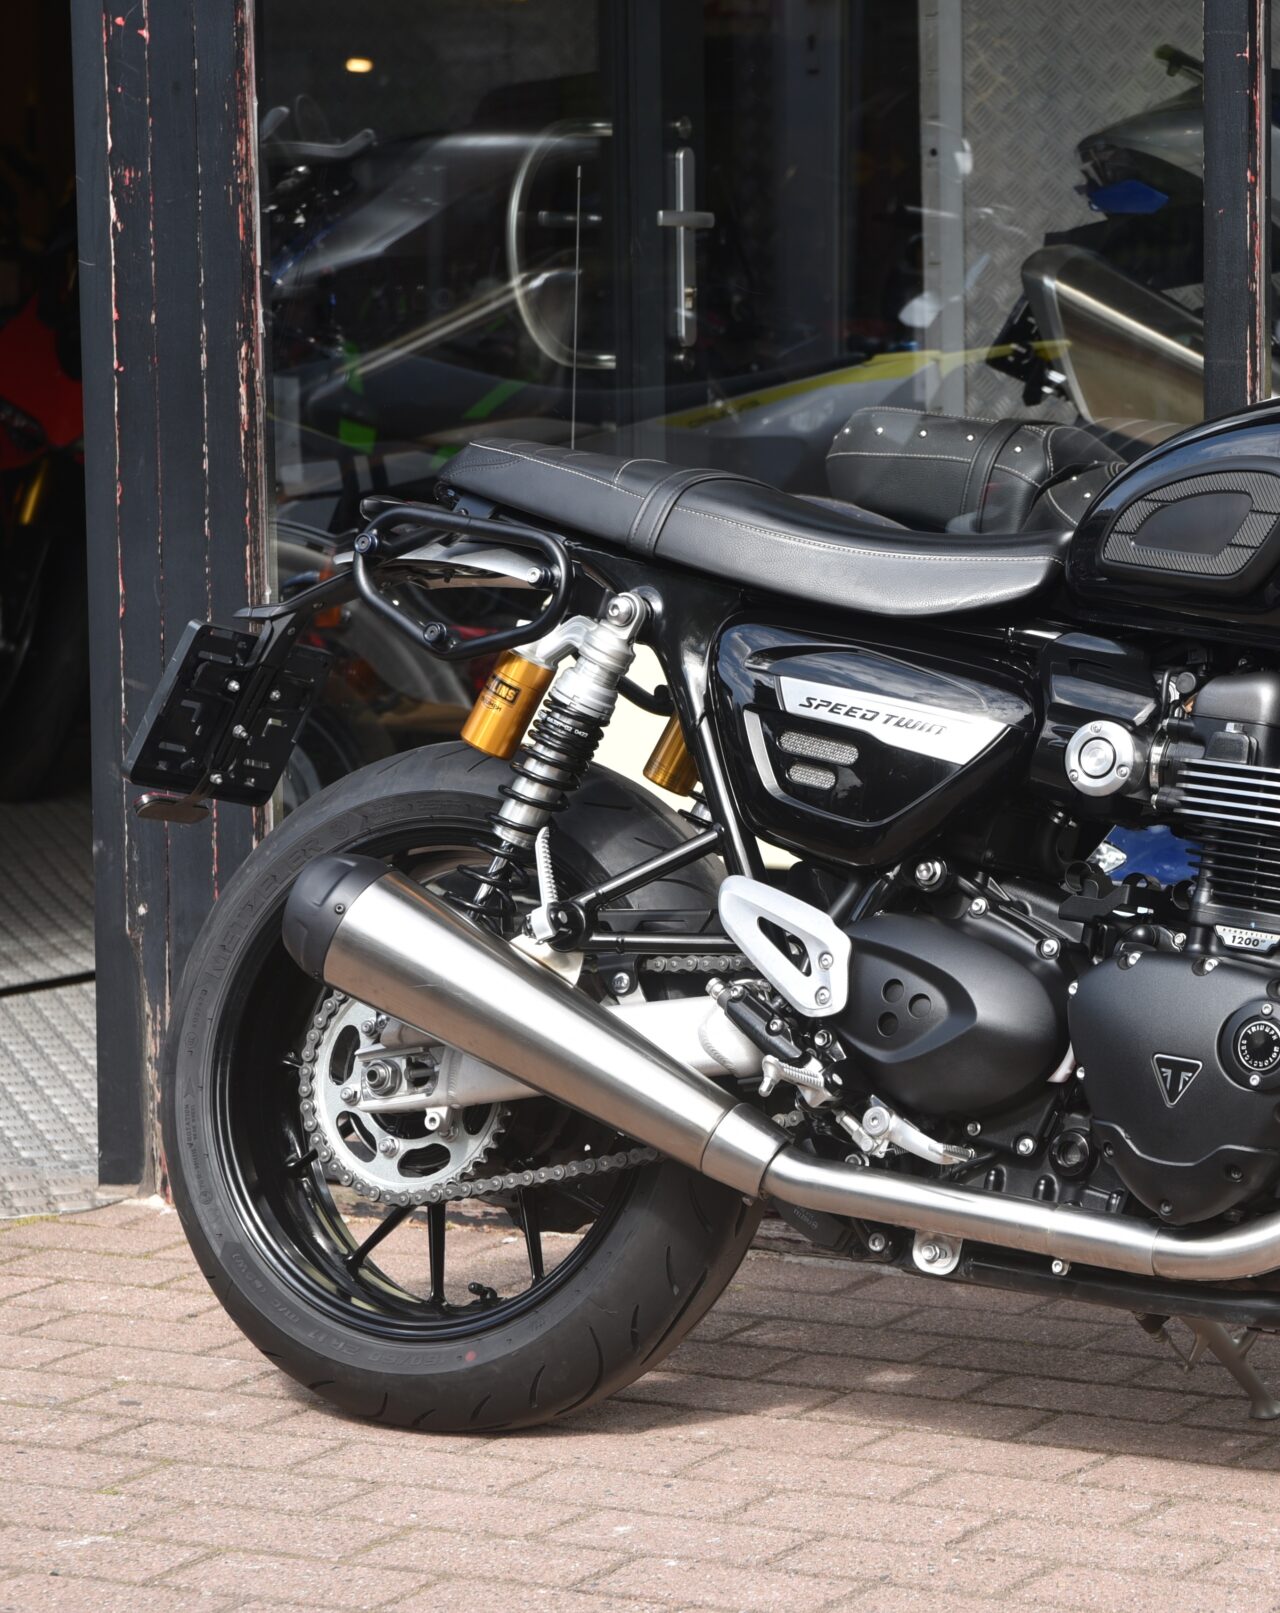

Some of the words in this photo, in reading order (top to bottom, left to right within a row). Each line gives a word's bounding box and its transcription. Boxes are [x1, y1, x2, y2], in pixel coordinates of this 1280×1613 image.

[485, 676, 517, 702] LINS
[799, 696, 881, 722] SPEED
[1232, 935, 1260, 948] 1200
[1247, 1024, 1278, 1040] TRIUMPH
